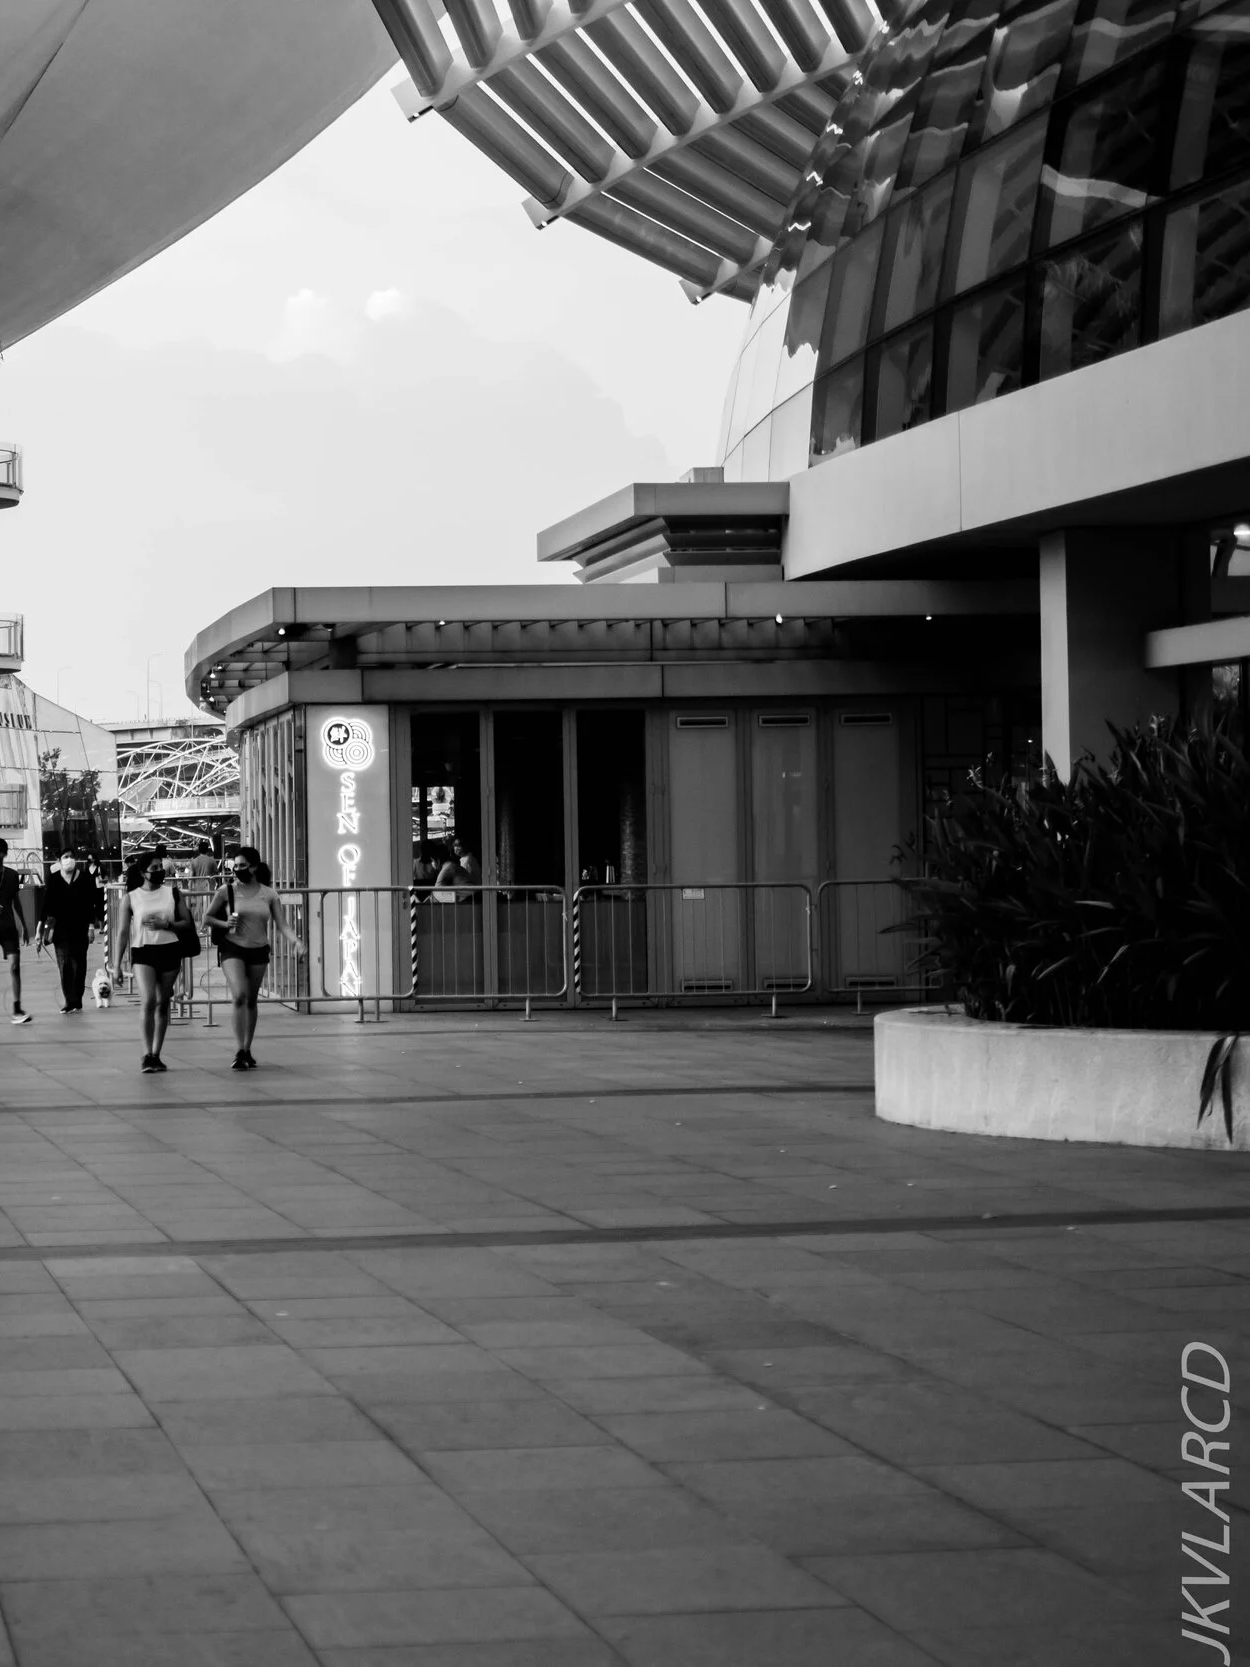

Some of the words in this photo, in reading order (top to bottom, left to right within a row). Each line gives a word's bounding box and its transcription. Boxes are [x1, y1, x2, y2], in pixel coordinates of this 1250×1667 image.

[336, 771, 362, 835] SEN
[337, 843, 362, 887] OF
[339, 896, 363, 997] JAPAN
